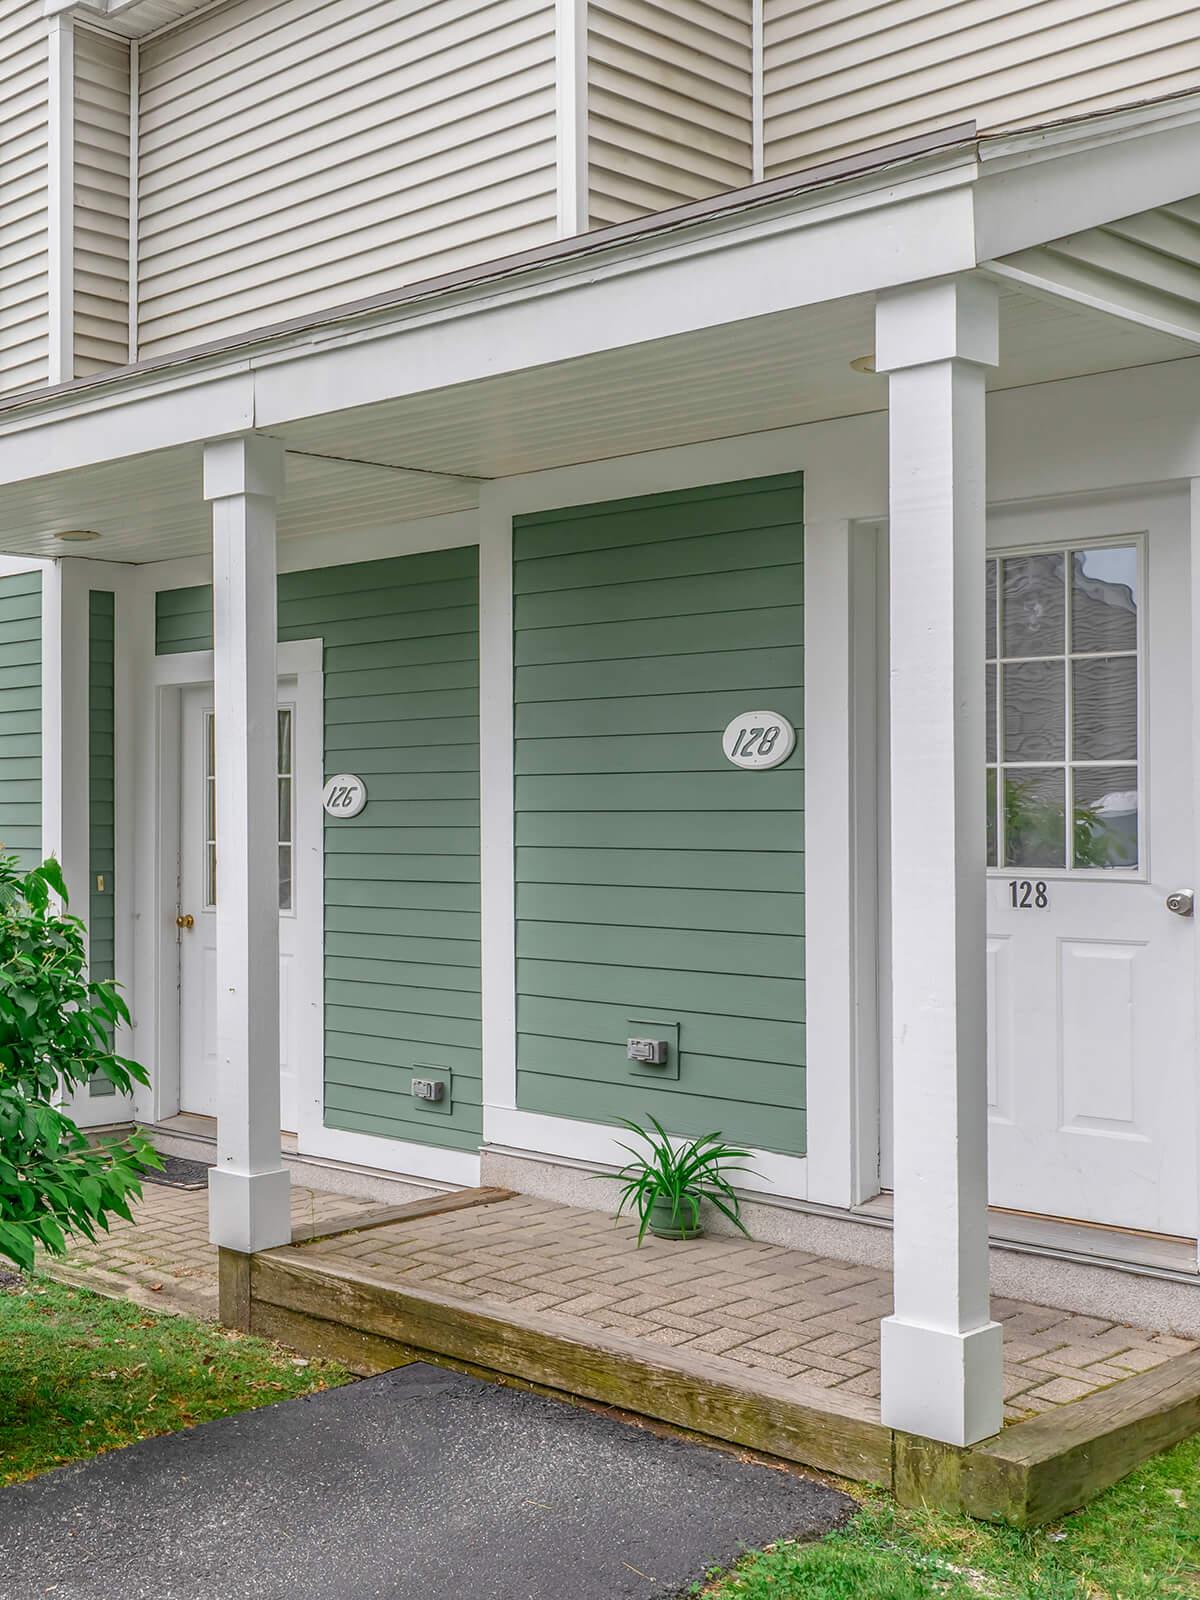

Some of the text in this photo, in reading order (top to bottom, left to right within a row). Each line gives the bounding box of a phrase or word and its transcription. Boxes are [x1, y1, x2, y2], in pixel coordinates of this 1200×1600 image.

[731, 726, 780, 757] 128
[326, 786, 358, 807] 126
[1009, 880, 1048, 908] 128
